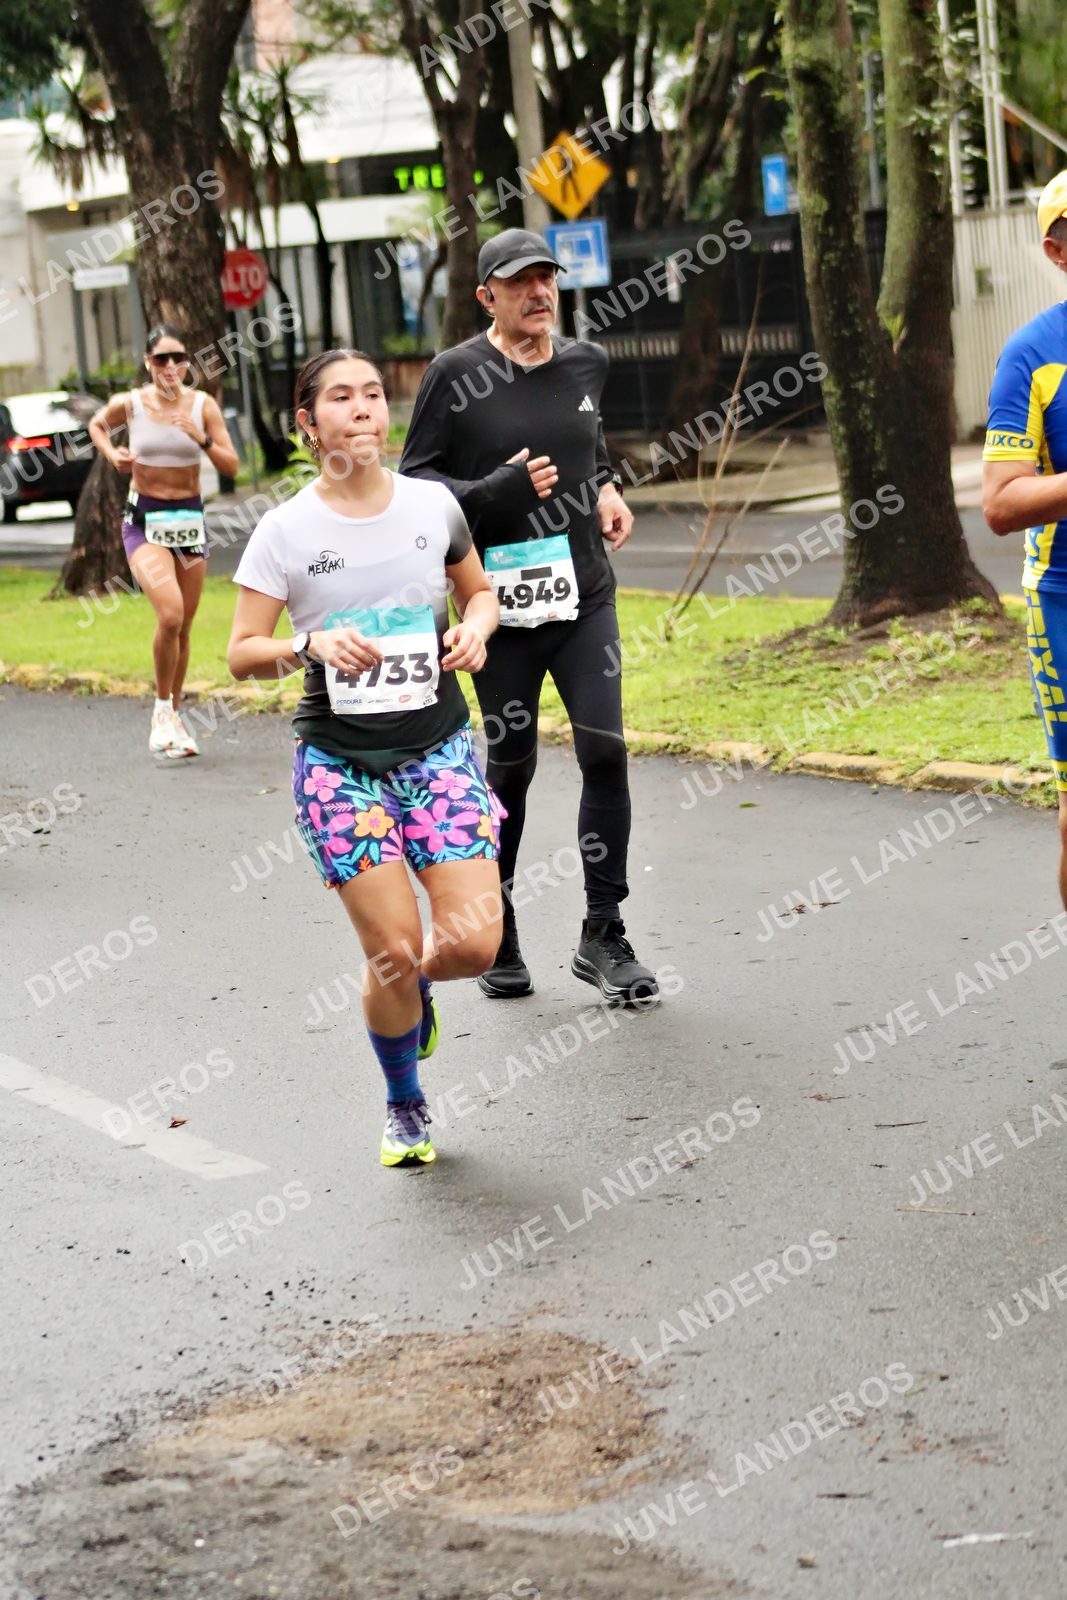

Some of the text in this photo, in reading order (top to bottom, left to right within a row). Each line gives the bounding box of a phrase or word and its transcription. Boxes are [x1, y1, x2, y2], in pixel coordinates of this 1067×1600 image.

[152, 529, 198, 544] 4559
[307, 558, 345, 577] MERAKI
[497, 576, 571, 610] 4949
